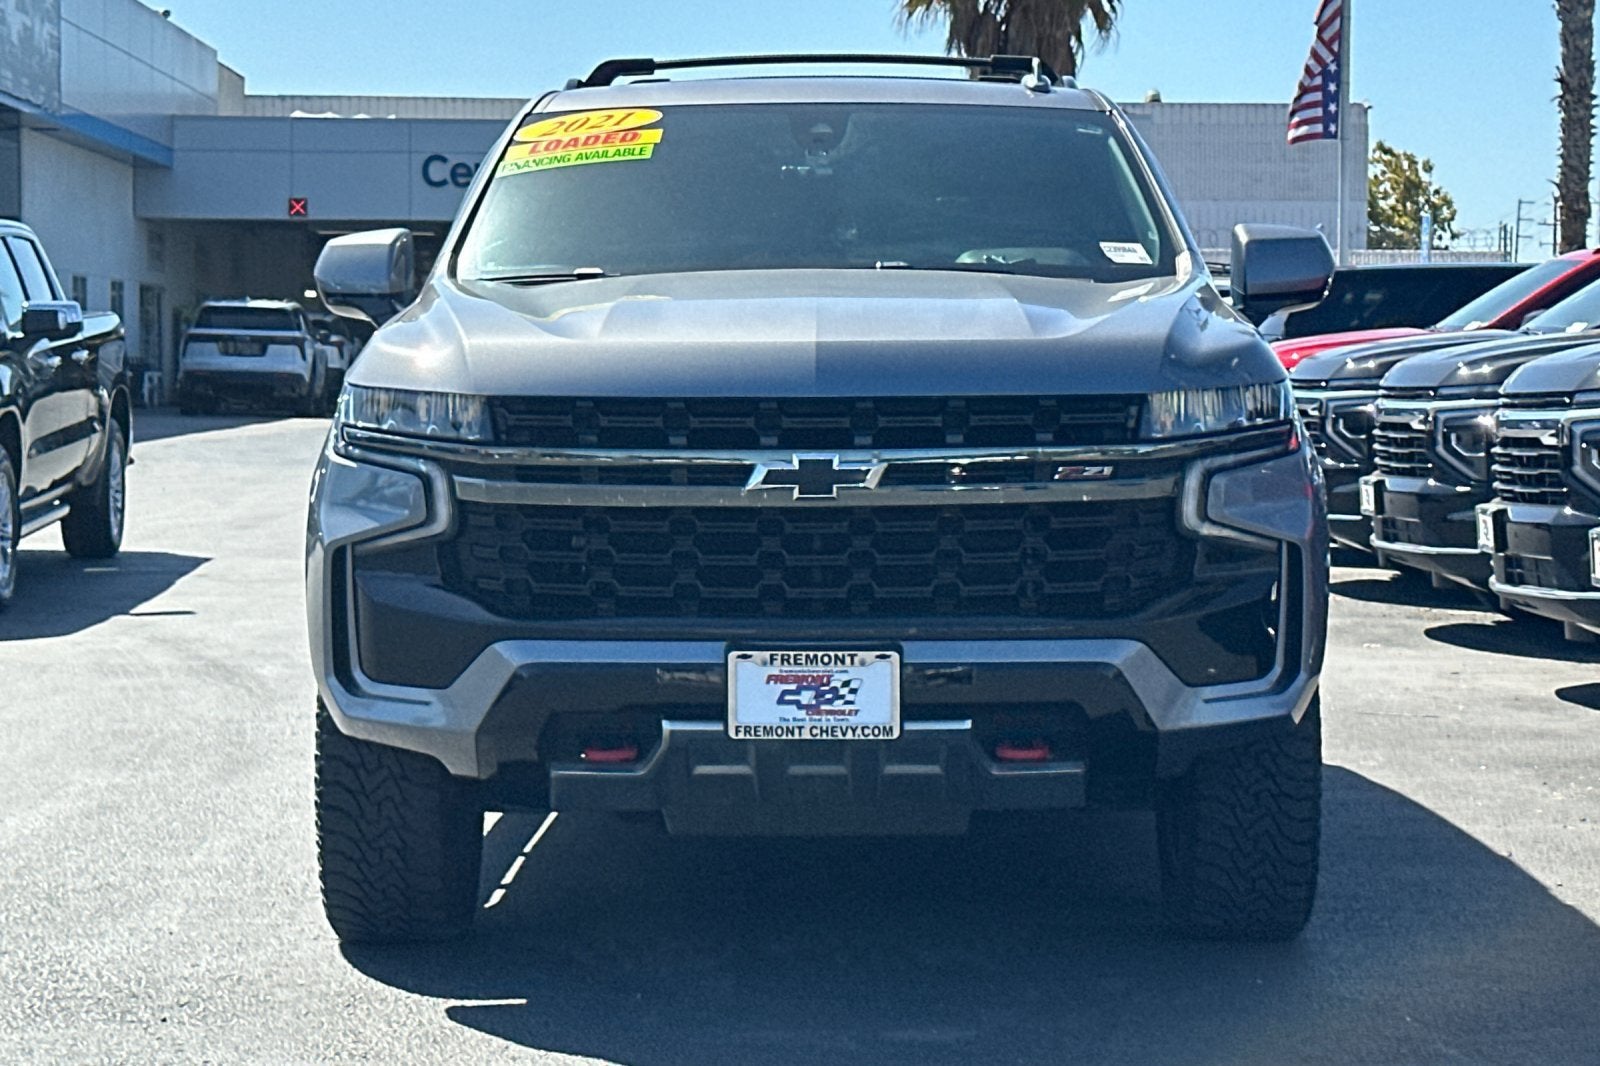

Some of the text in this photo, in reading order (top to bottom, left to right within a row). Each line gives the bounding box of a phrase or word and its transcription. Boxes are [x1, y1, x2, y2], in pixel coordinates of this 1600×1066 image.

[538, 111, 636, 137] 2021
[528, 131, 640, 155] LOADED
[574, 146, 648, 161] AVAILABLE
[422, 154, 480, 189] Ce
[769, 653, 858, 666] FREMONT
[735, 725, 893, 738] FREMONT CHEVY.COM
